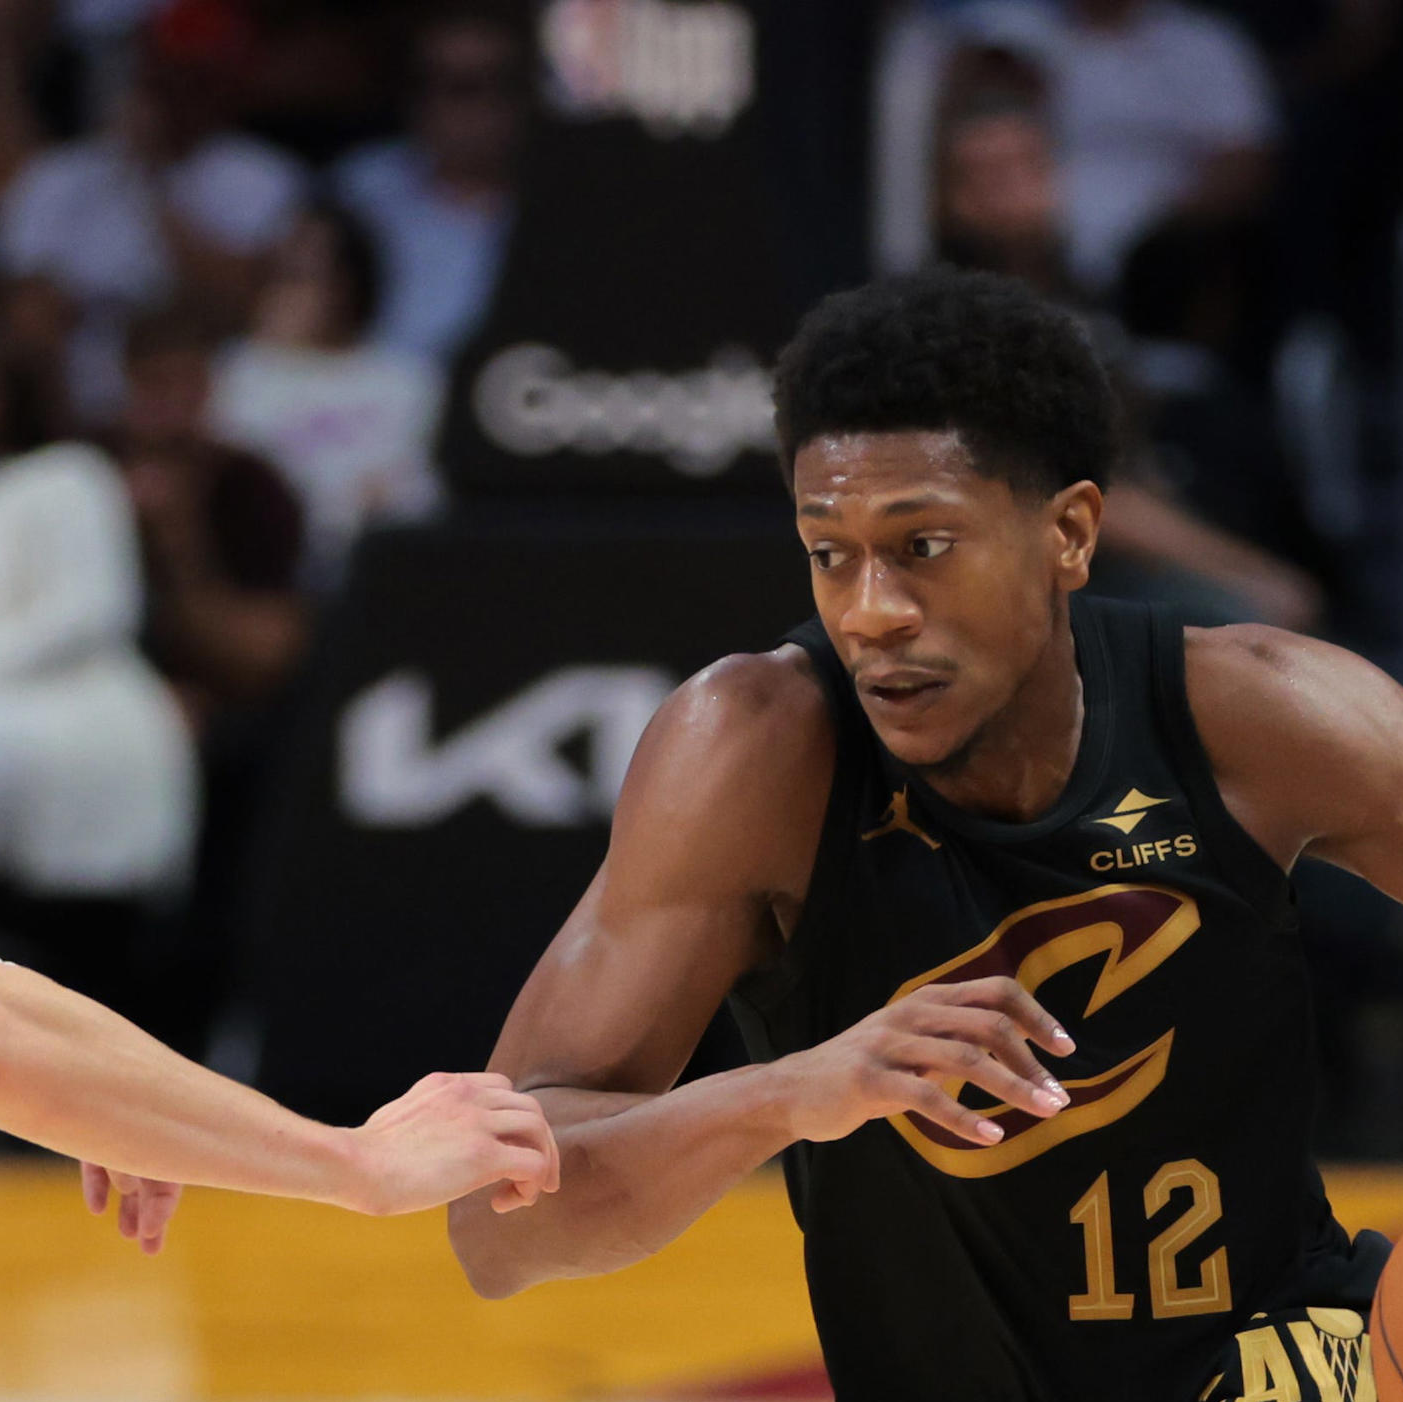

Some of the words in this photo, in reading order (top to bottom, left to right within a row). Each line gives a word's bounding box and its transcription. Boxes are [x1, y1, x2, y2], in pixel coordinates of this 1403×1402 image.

[474, 346, 778, 476] Googl
[1089, 833, 1197, 872] CLIFFS
[1068, 1158, 1233, 1321] 12
